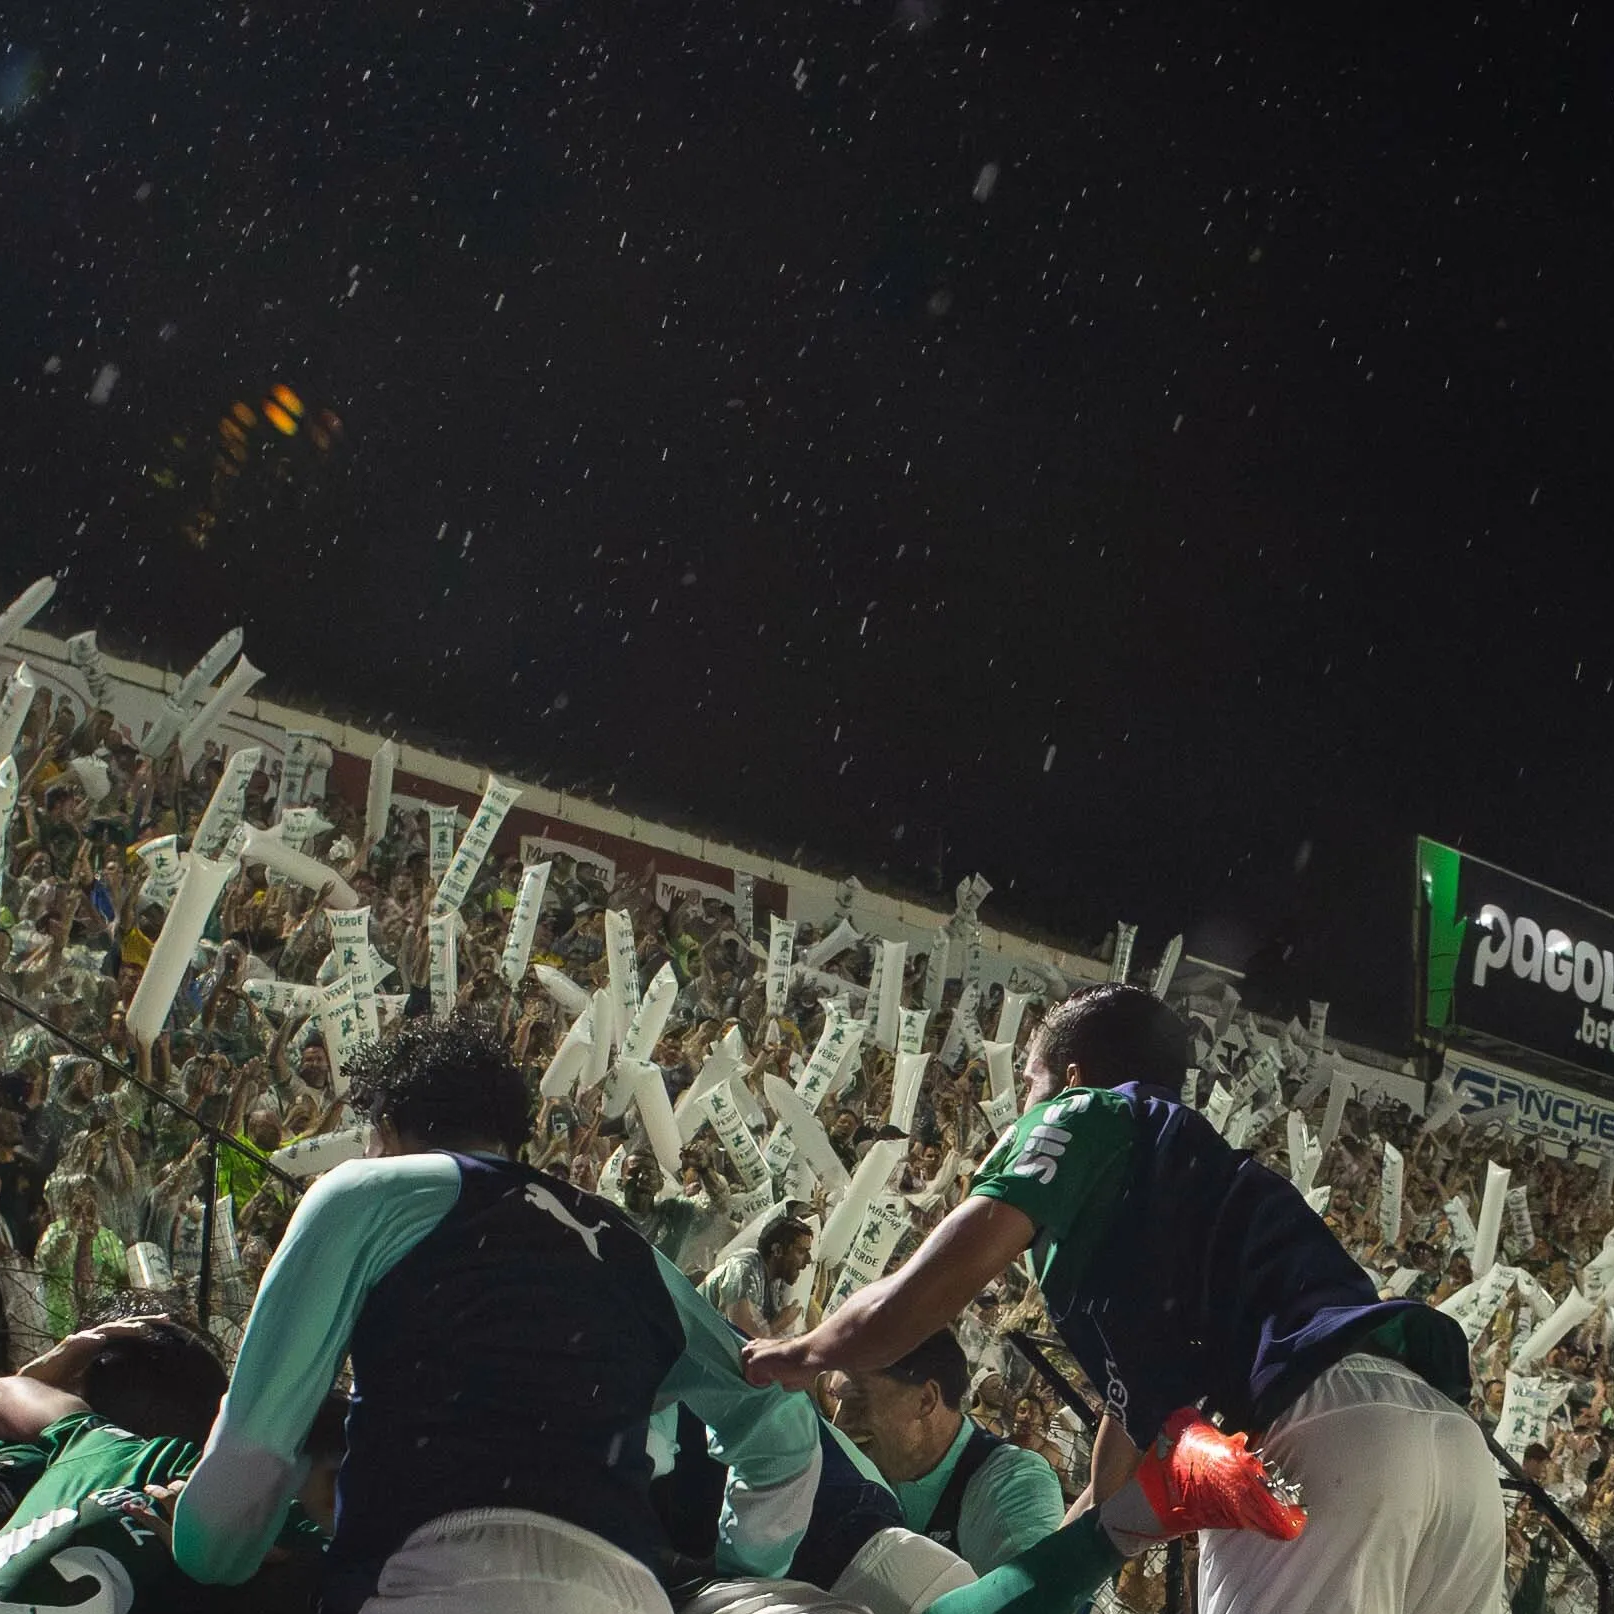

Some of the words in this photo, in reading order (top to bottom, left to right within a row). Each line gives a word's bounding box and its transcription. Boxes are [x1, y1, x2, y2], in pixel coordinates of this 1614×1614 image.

[331, 915, 363, 927] VERDE
[743, 1195, 772, 1214] VERDE
[867, 1203, 902, 1231] MANCHA
